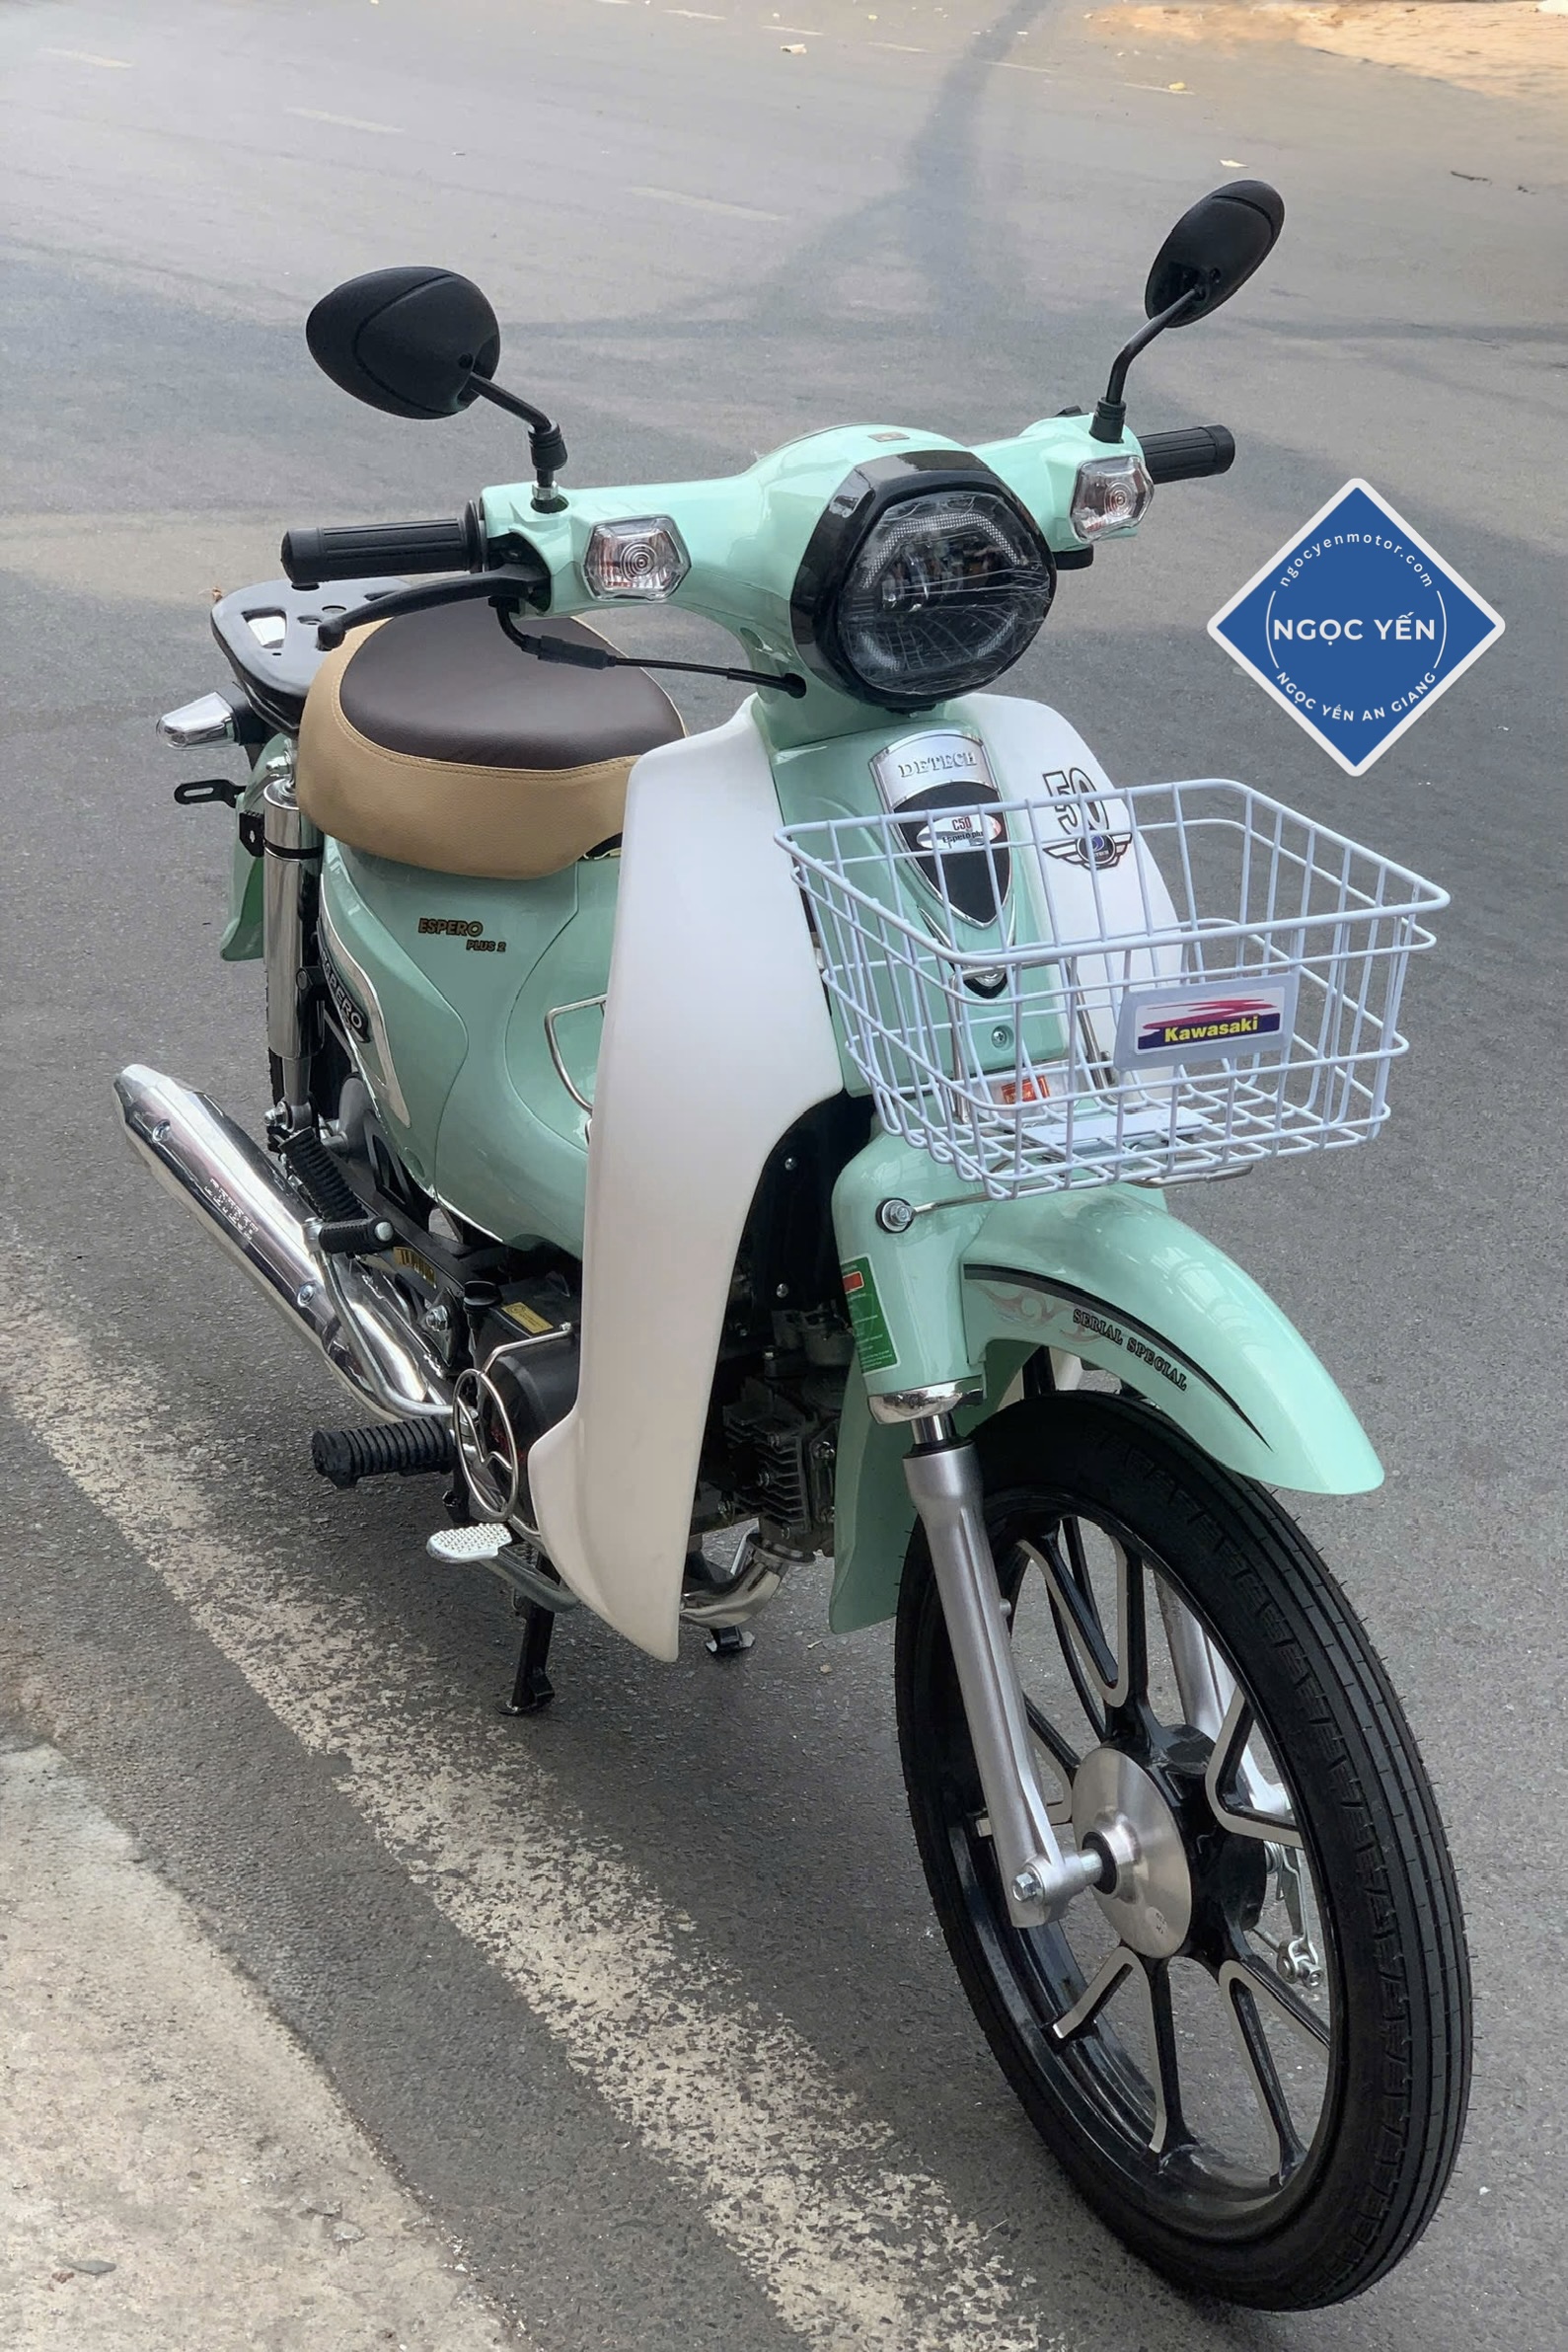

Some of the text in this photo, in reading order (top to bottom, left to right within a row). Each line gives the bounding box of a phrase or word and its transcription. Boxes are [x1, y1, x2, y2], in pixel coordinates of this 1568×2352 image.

[897, 751, 978, 778] DETECH
[1042, 767, 1110, 837] 50
[951, 815, 973, 831] C50
[418, 917, 484, 938] ESPERO
[466, 939, 507, 953] PLUS 2
[1164, 1015, 1259, 1043] Kawasaki
[1072, 1308, 1188, 1392] SERIAL SPECIAL
